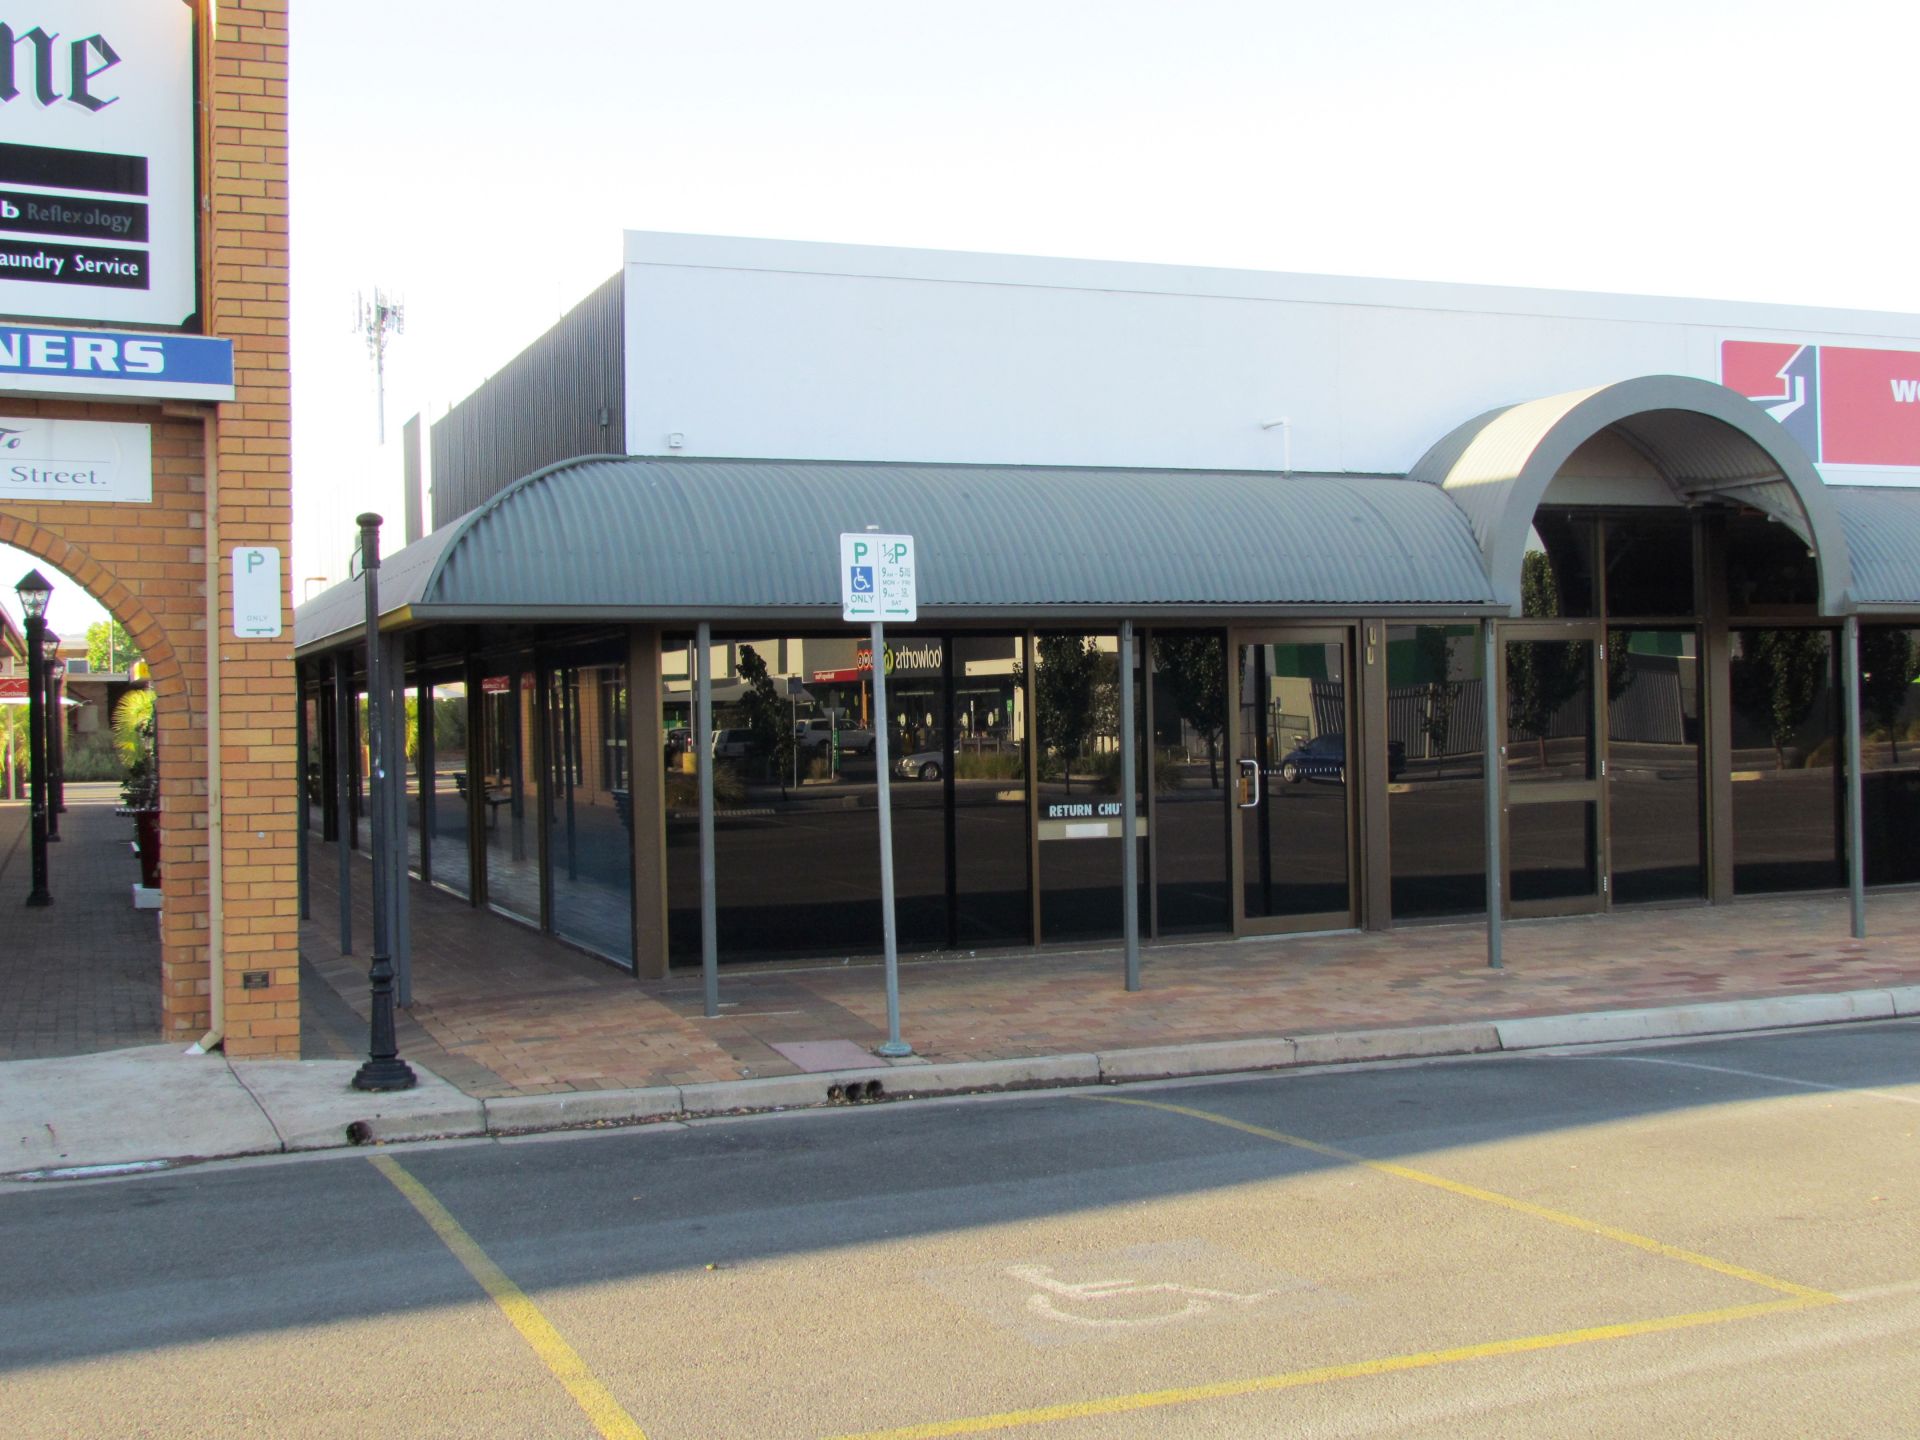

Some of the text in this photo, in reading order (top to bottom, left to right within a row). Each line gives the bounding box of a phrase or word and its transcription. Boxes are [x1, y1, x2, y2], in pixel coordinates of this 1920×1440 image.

[27, 202, 133, 233] Reflexology
[0, 251, 139, 276] aundry Service
[10, 466, 107, 484] Street.
[247, 552, 265, 573] P
[854, 542, 868, 564] P
[850, 594, 874, 604] ONLY
[1049, 803, 1122, 817] RETURN CHU
